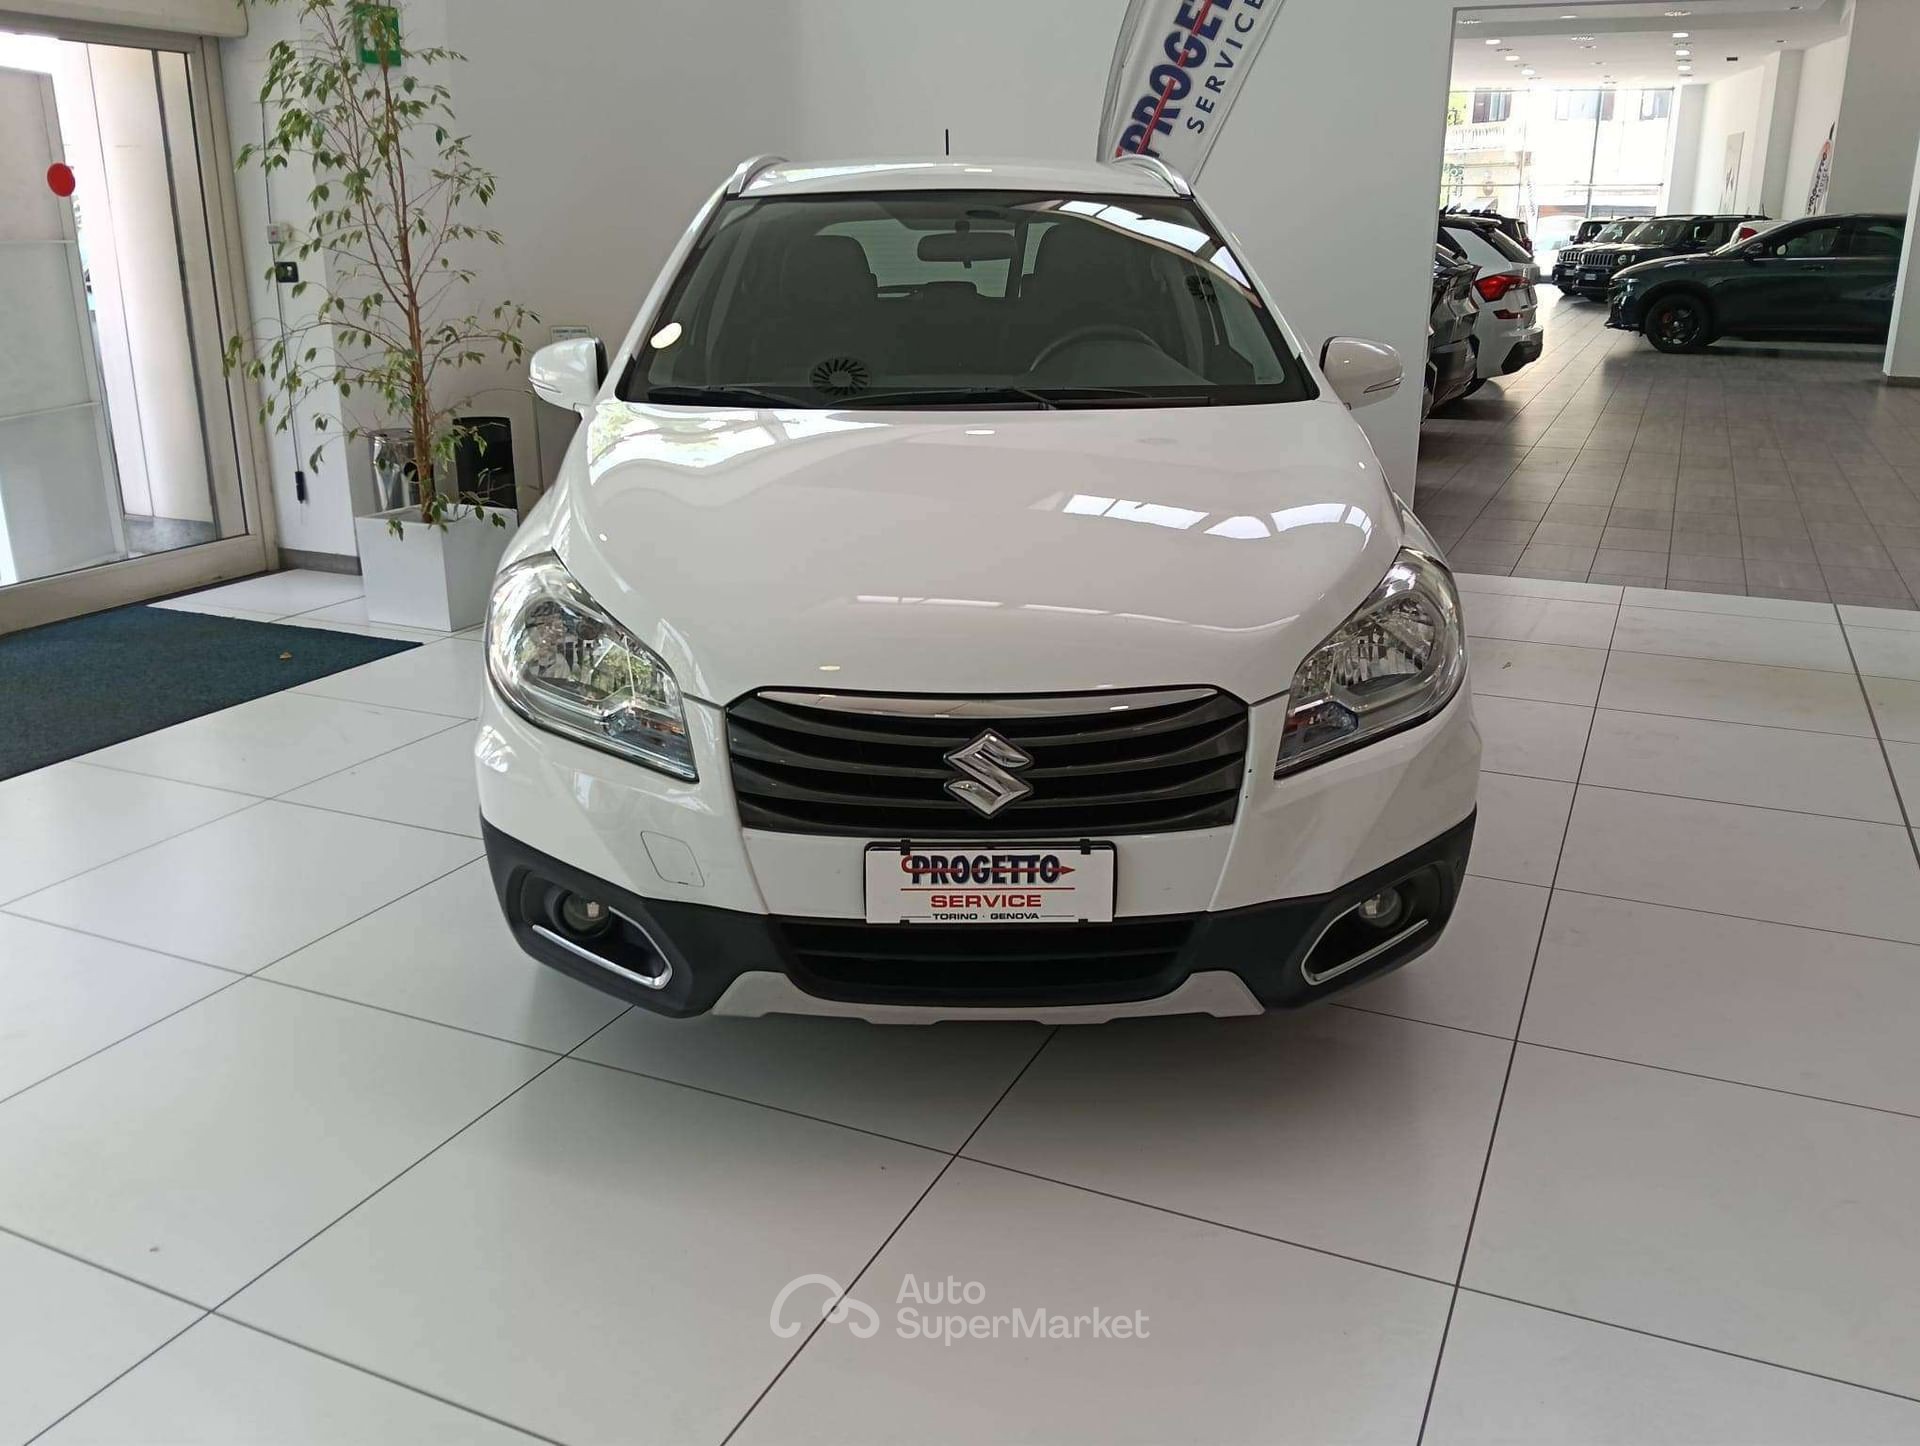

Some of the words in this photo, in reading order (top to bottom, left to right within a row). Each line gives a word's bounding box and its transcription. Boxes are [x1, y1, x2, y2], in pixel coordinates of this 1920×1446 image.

[1119, 0, 1232, 158] PROGE
[911, 854, 1061, 885] PROGETTO
[930, 894, 1042, 909] SERVICE
[932, 913, 978, 921] TORINO
[990, 912, 1040, 921] GENOVA
